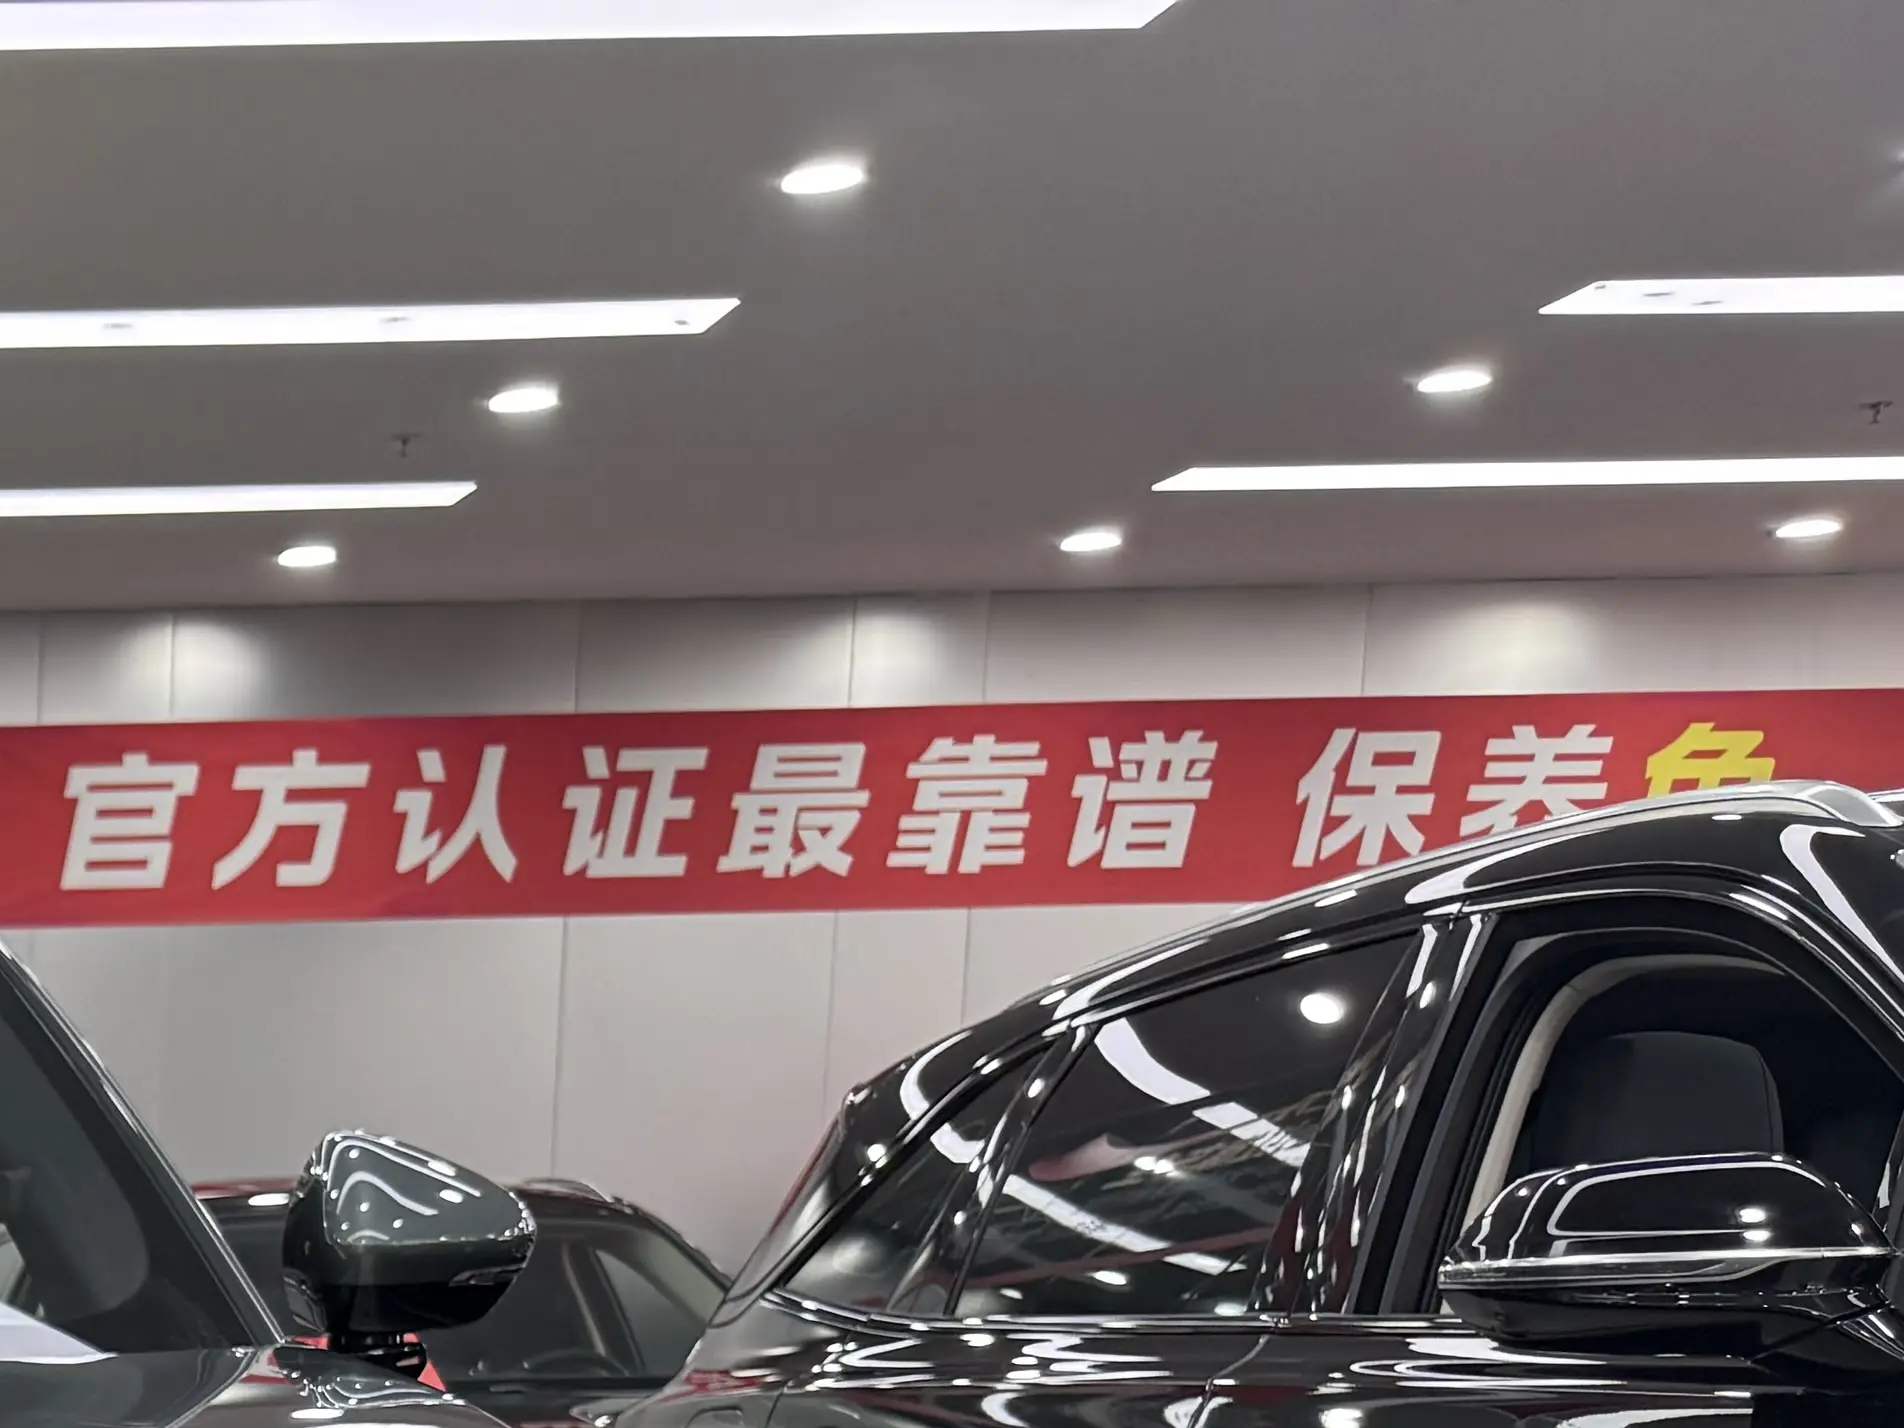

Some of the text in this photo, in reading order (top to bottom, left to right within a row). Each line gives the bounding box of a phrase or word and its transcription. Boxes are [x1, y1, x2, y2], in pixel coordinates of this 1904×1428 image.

[57, 728, 1217, 892] 官方认证最靠谱
